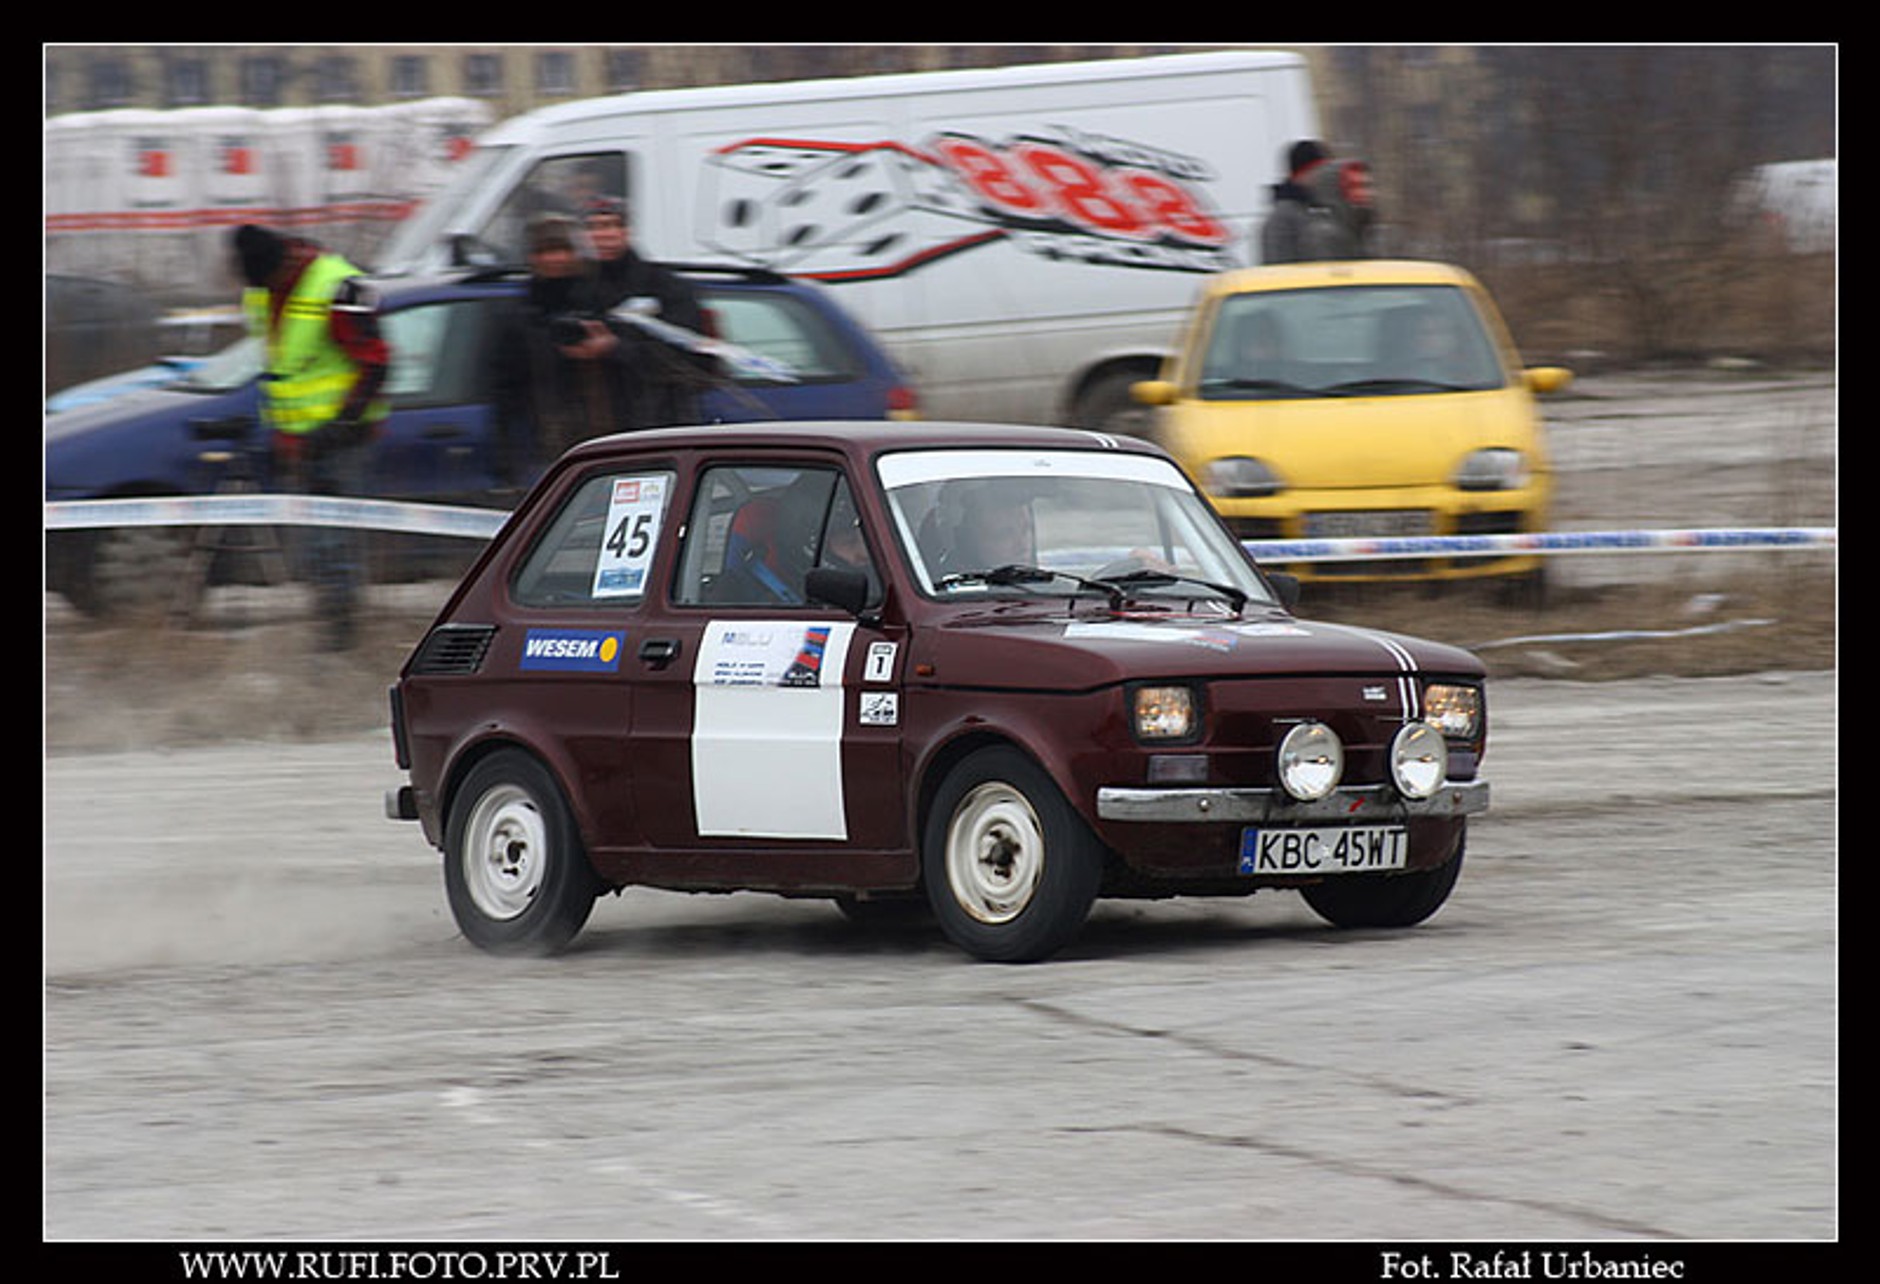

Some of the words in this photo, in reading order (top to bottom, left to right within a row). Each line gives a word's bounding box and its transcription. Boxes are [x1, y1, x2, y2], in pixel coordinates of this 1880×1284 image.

[606, 514, 652, 558] 45
[526, 639, 598, 658] WESEM
[876, 656, 885, 674] 1
[1259, 832, 1321, 869] KBC
[1333, 829, 1407, 867] 45WT
